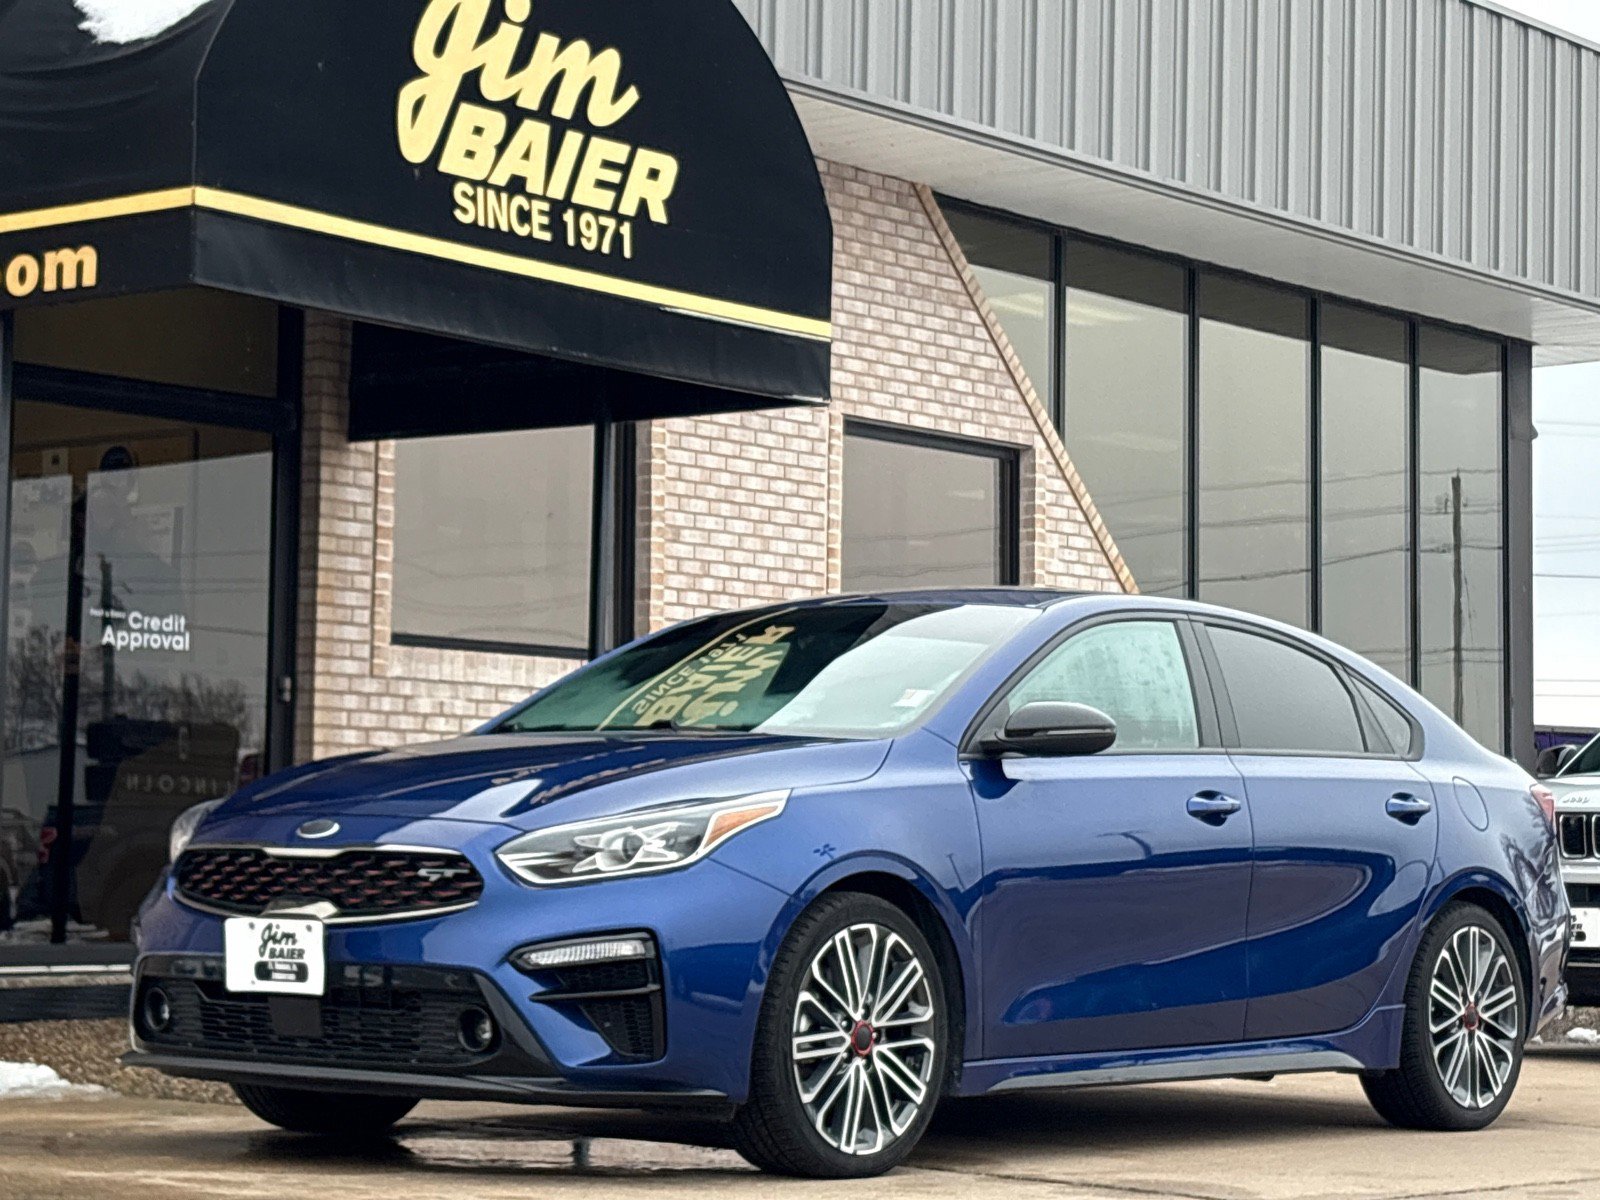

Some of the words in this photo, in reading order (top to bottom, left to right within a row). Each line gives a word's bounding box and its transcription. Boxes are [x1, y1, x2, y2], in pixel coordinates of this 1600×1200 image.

[397, 0, 640, 164] Jim
[437, 102, 678, 225] BAIER
[453, 181, 553, 242] SINCE
[562, 208, 632, 259] 1971
[0, 245, 97, 297] om
[101, 624, 190, 652] Approval
[128, 611, 186, 633] Credit
[258, 922, 298, 958] Jim
[268, 947, 306, 960] BAIER
